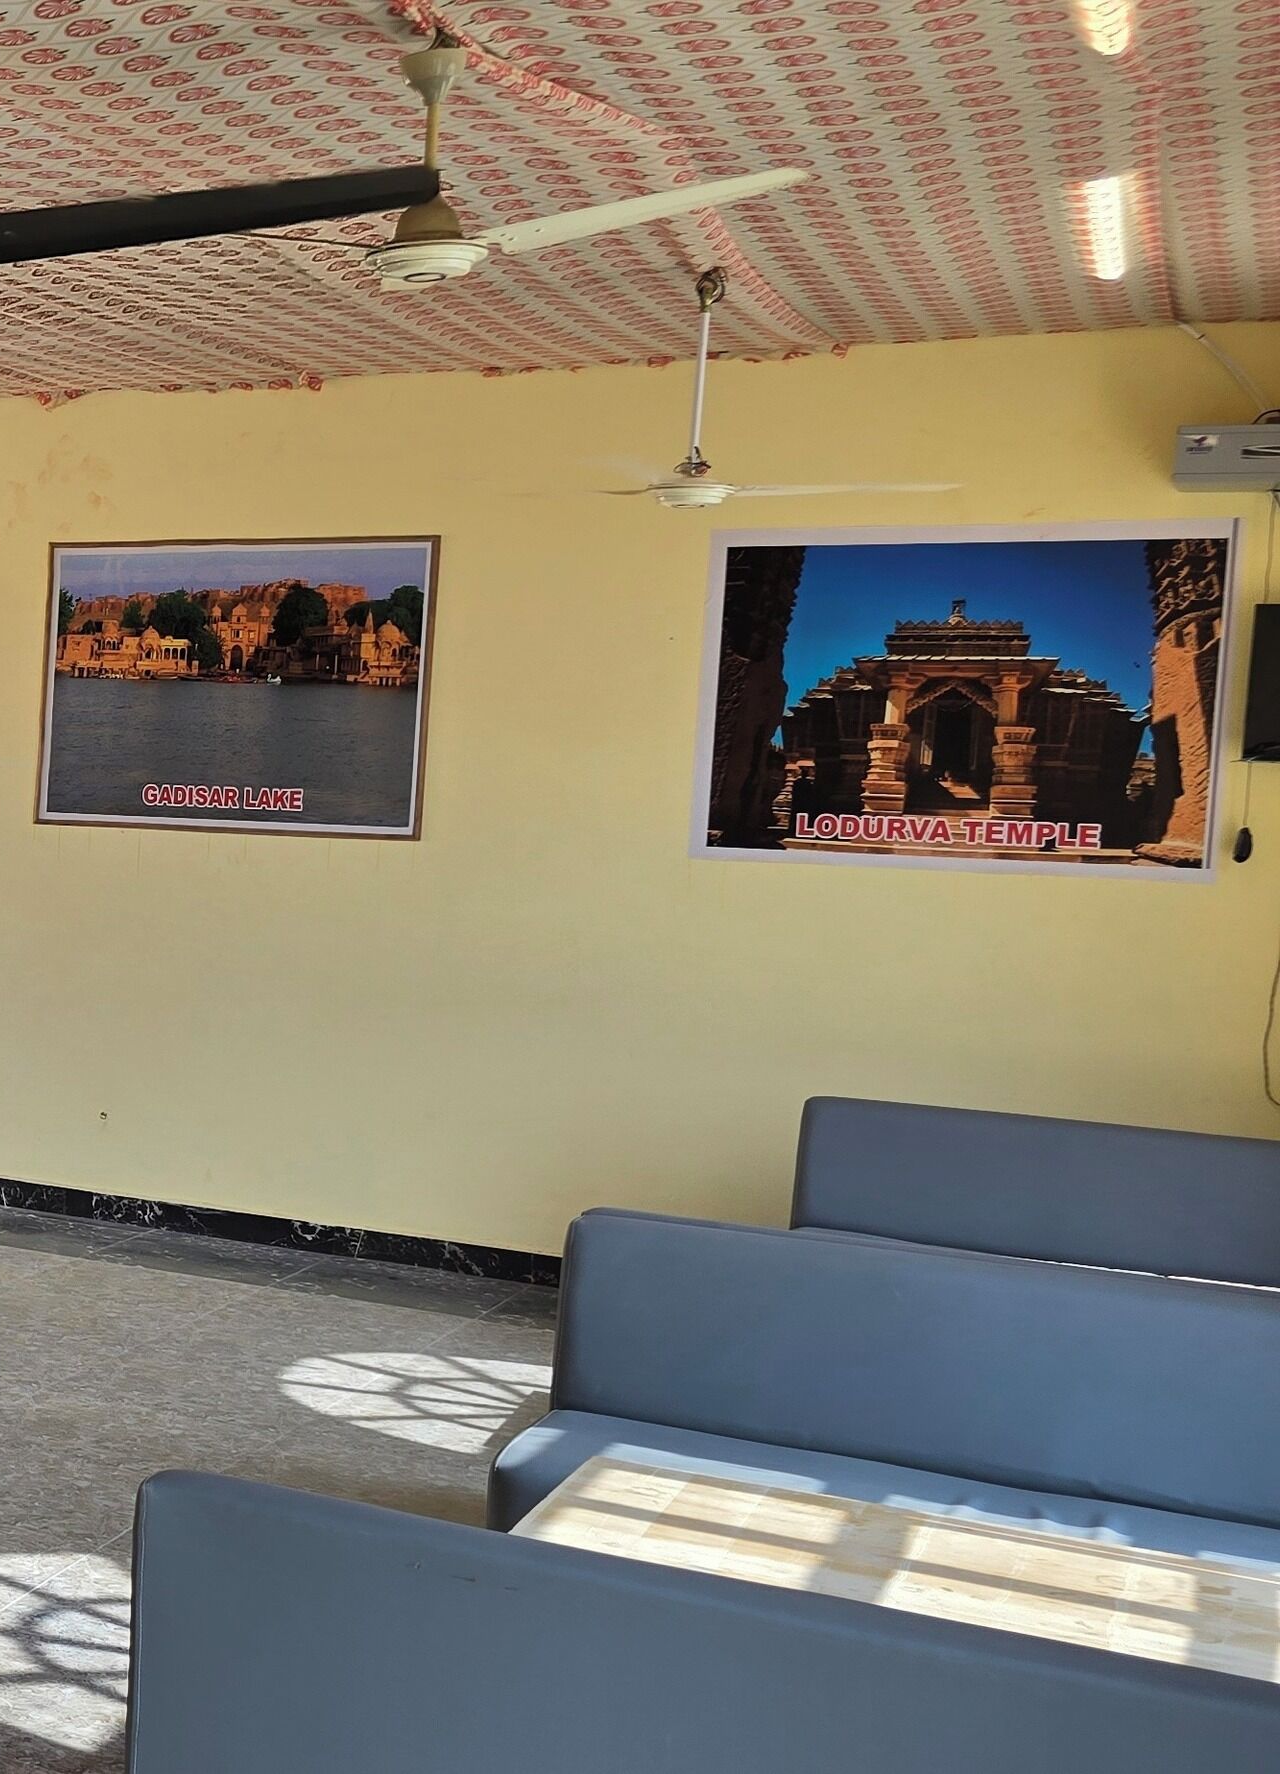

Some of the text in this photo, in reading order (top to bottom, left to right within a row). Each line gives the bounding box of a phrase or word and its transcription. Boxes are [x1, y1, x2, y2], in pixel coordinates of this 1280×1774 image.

[143, 784, 303, 811] GADISAR LAKE
[796, 813, 1101, 848] LODURVA TEMPLE
